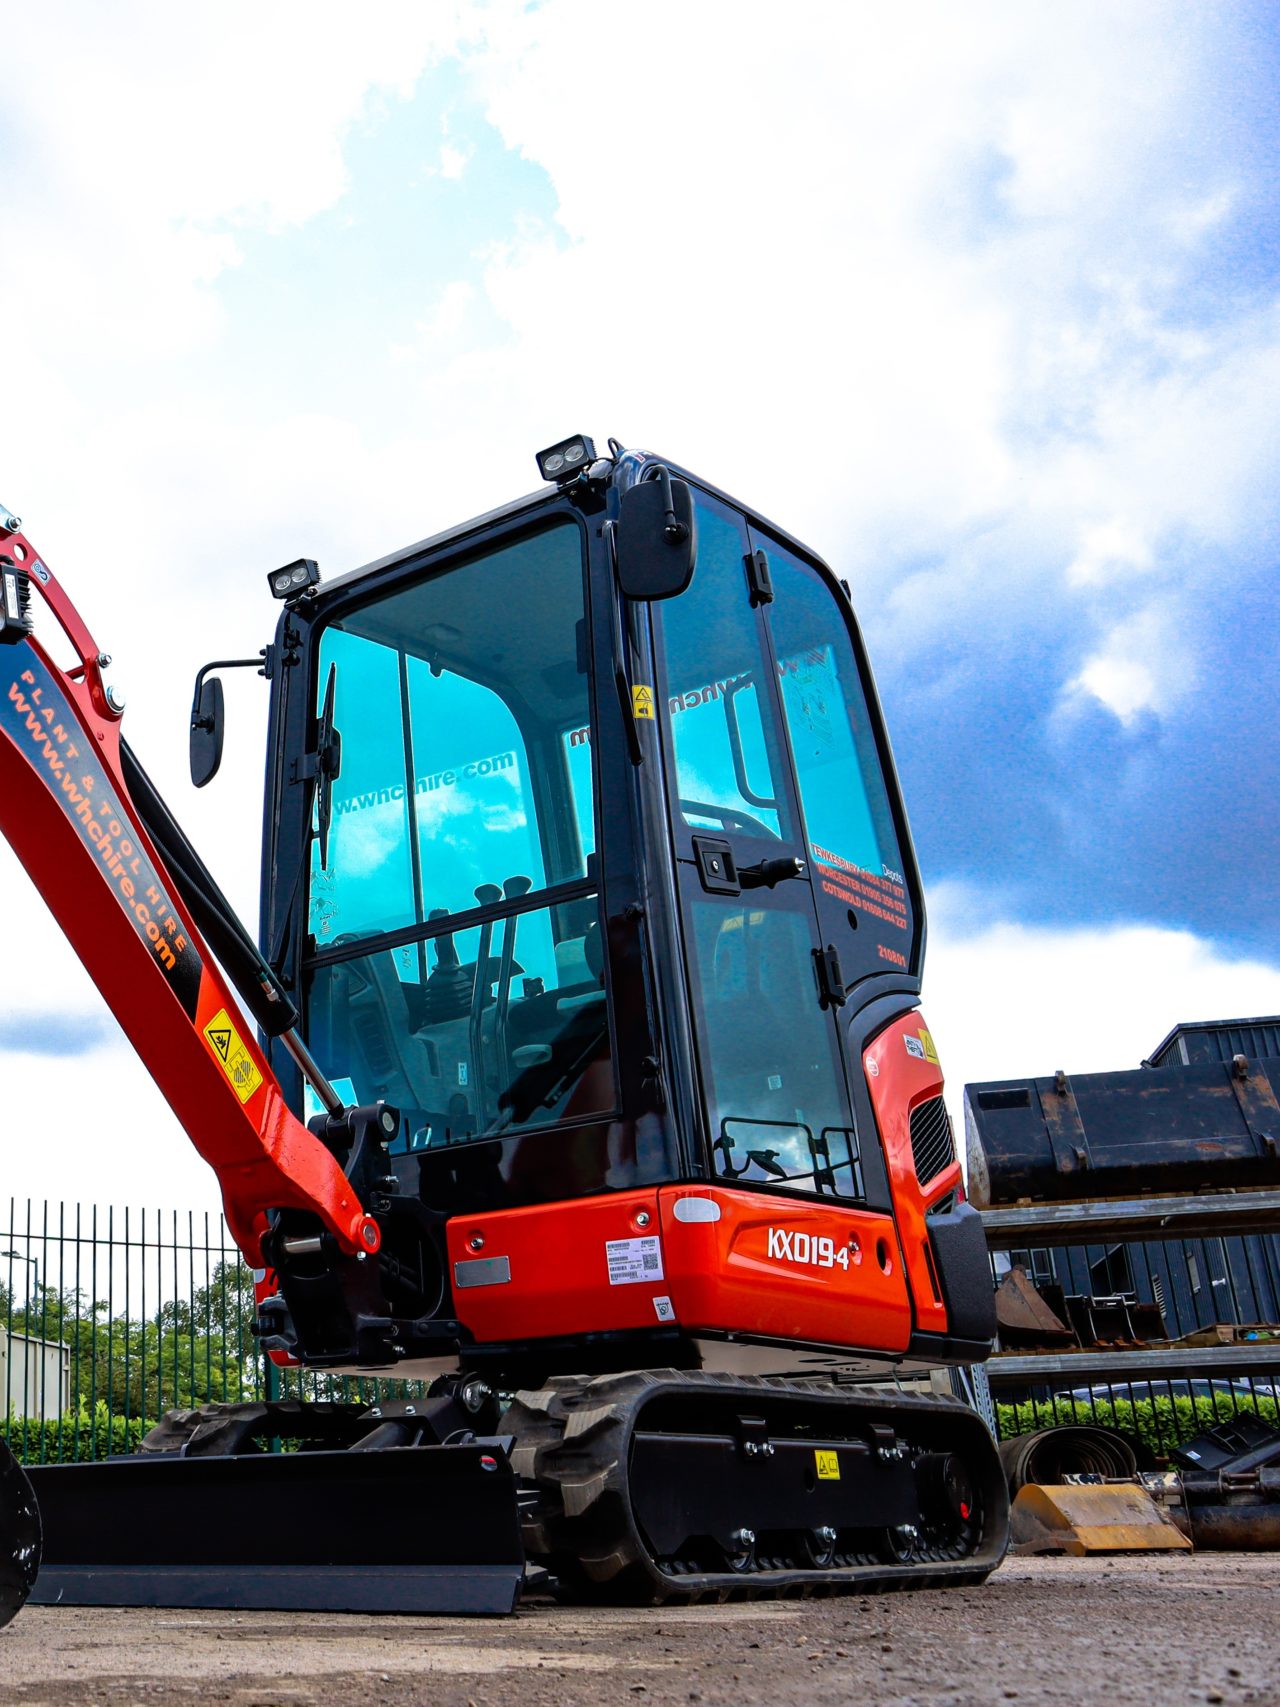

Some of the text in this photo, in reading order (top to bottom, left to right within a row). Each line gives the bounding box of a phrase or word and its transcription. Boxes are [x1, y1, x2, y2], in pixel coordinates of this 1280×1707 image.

[8, 681, 176, 971] www.whchire.com
[21, 669, 187, 952] PLANT & TOOL HIRE
[816, 861, 861, 893] WORCESTER
[881, 863, 904, 885] Depots
[822, 880, 862, 908] COTSWOLD
